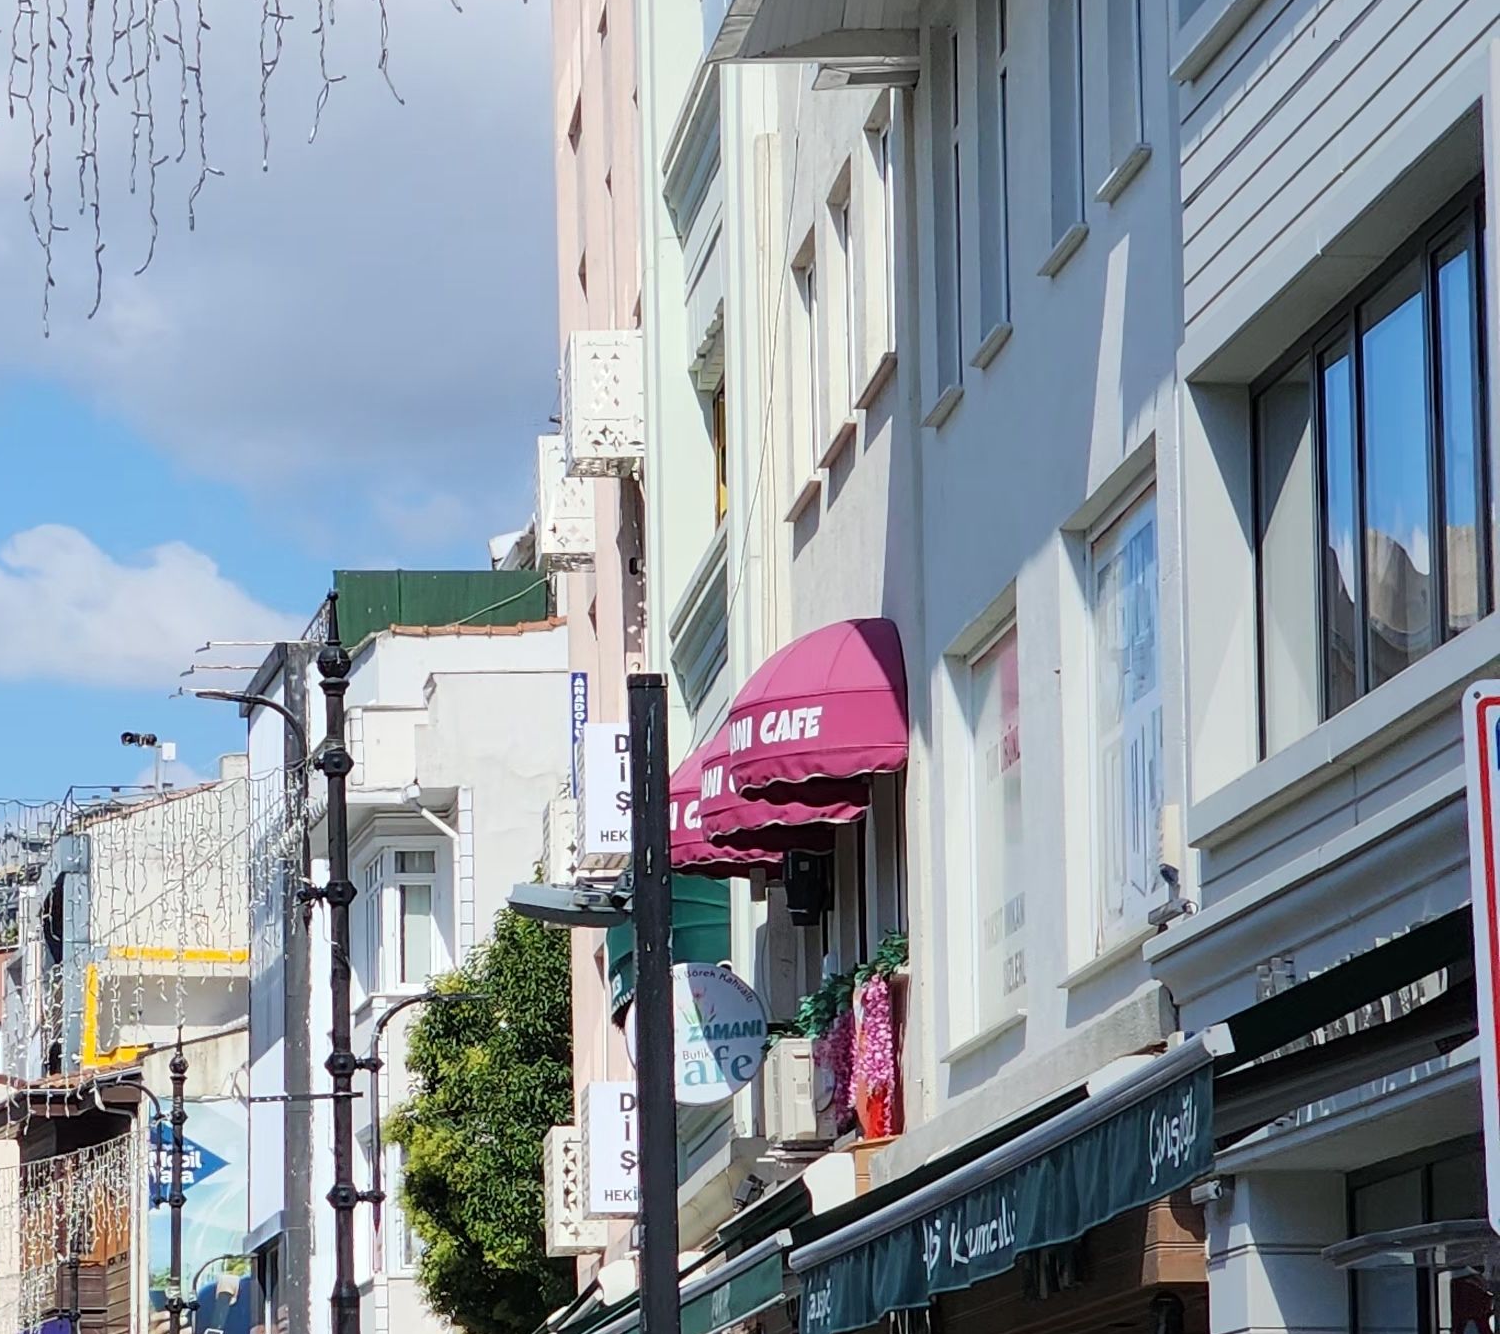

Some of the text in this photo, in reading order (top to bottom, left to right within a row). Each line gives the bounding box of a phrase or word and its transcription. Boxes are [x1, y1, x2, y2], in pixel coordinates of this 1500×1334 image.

[760, 707, 823, 744] CAFE
[687, 1019, 763, 1043] ZAMANI
[682, 1050, 710, 1061] Butik
[684, 1045, 756, 1086] afe
[619, 1092, 638, 1176] DİŞ
